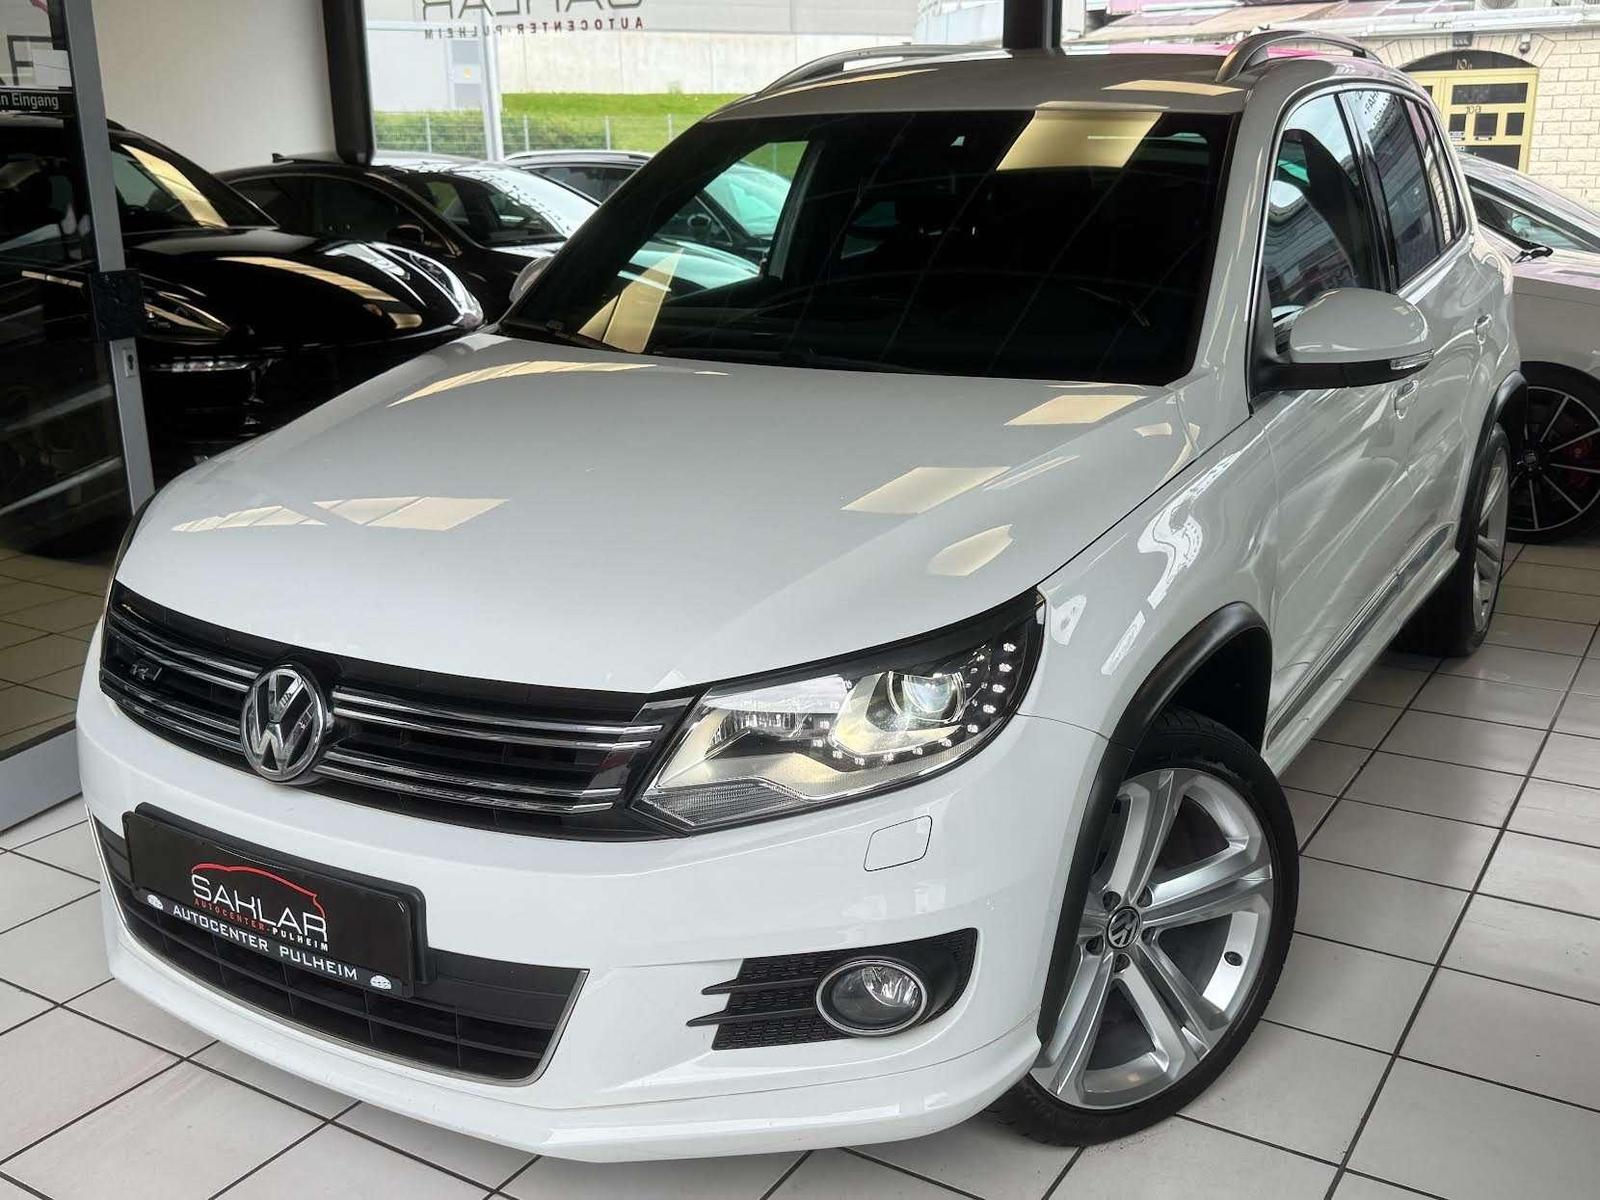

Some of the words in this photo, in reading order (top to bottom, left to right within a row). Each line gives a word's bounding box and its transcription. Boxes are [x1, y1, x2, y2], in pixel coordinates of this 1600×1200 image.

[11, 92, 59, 109] Eingang
[172, 904, 269, 952] AUTOCENTER
[279, 945, 358, 981] PULHEIM
